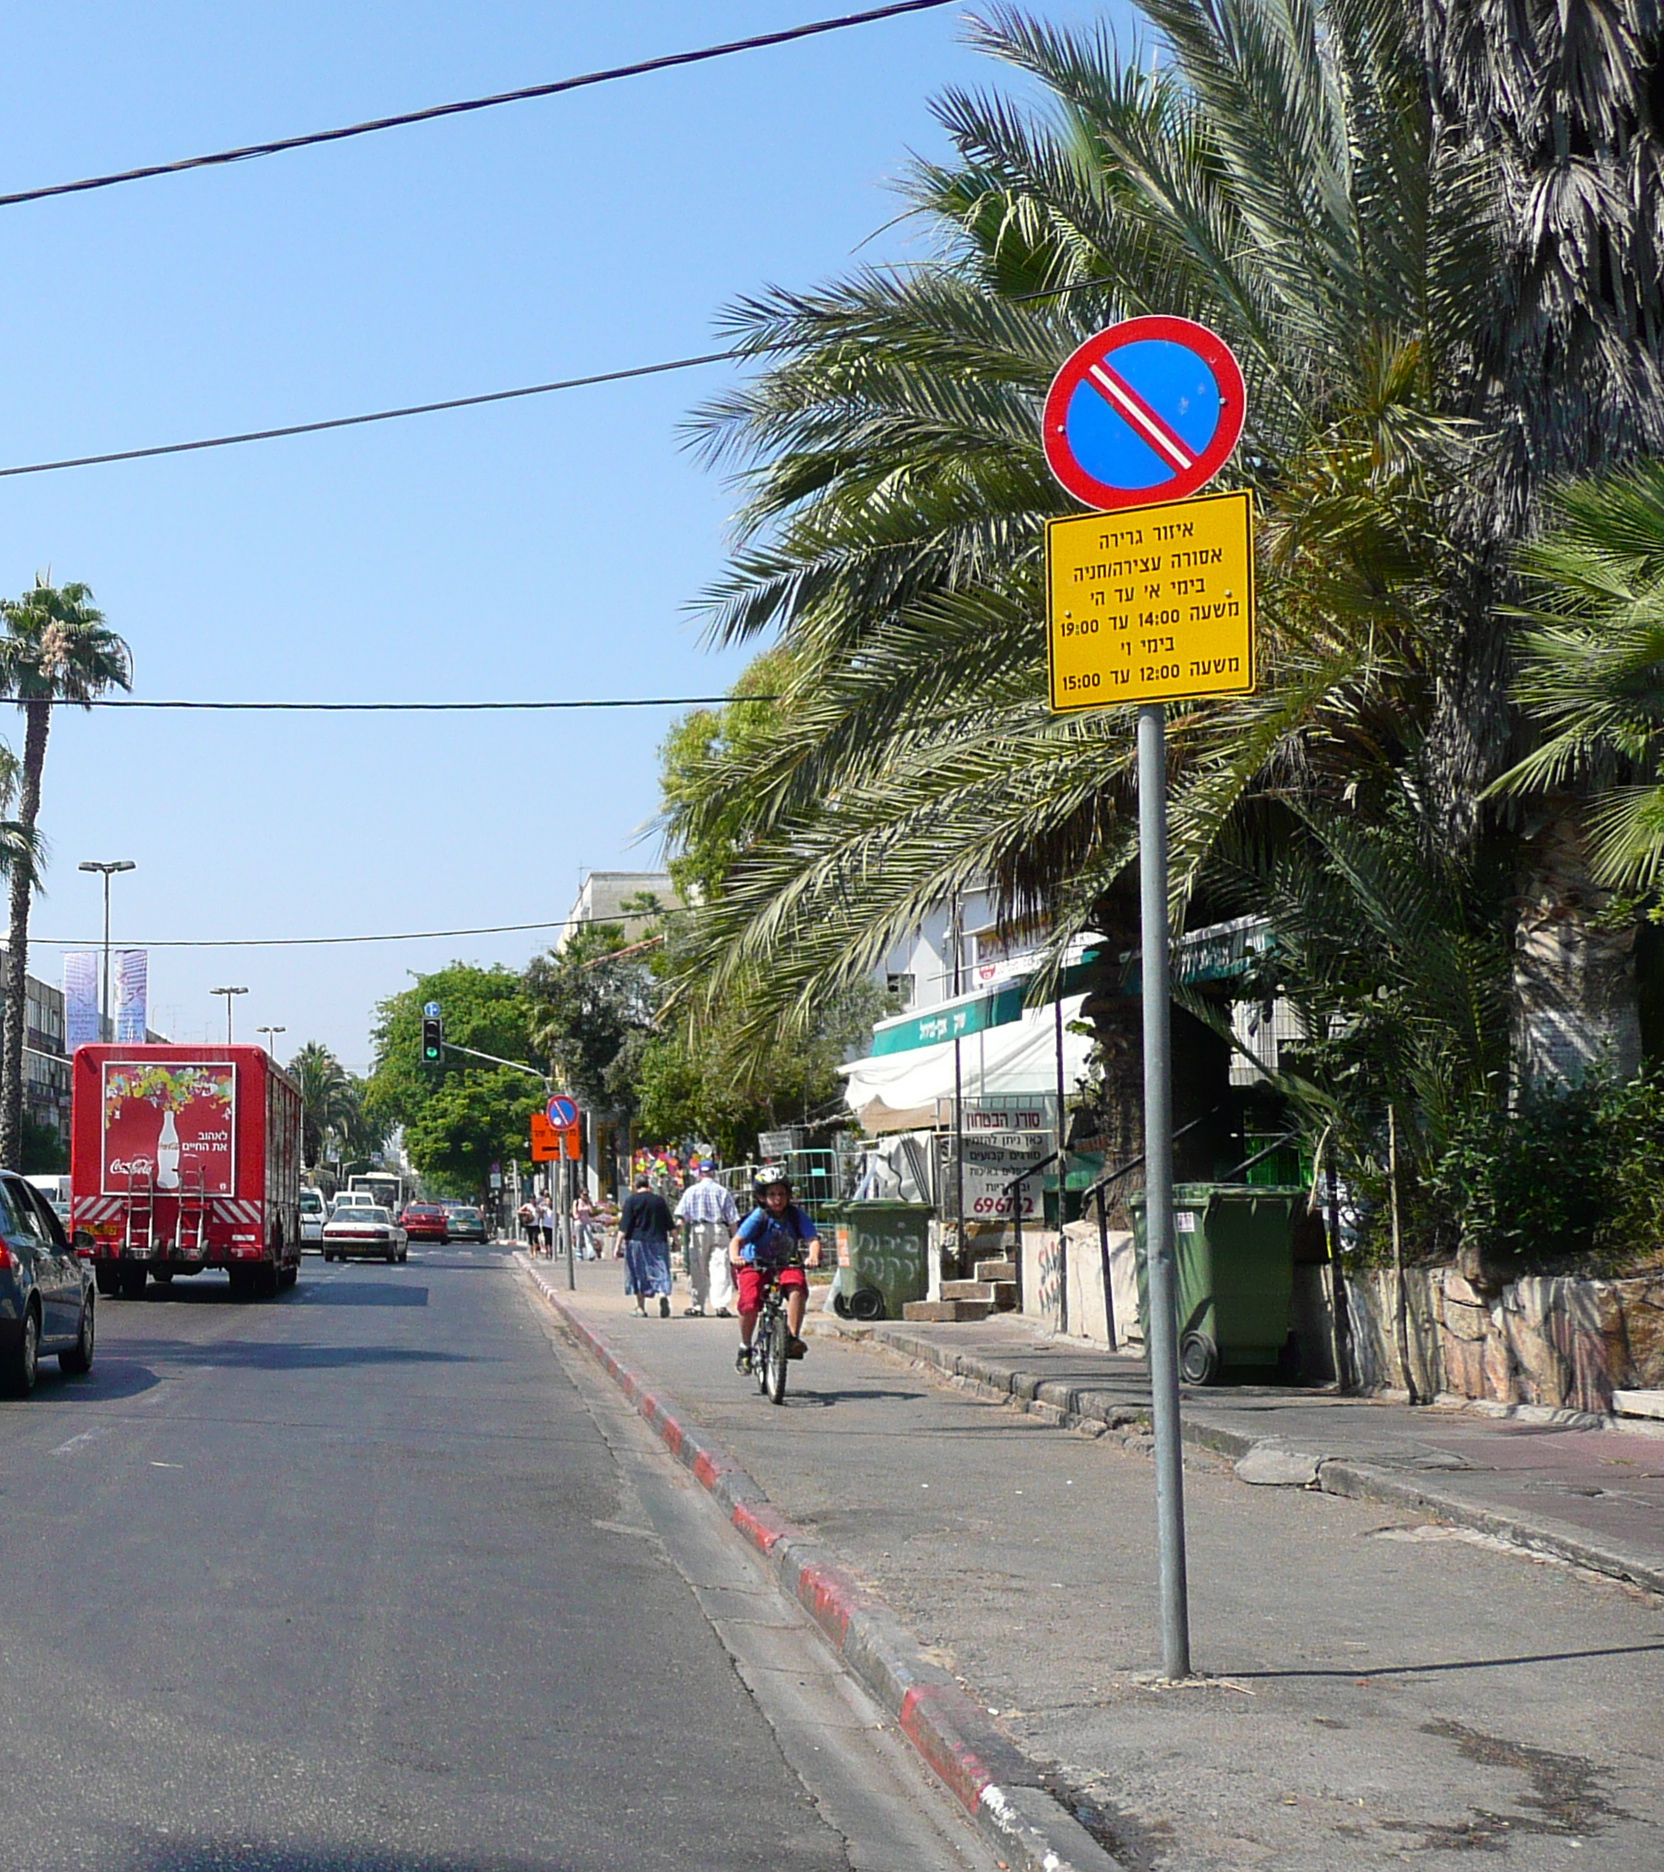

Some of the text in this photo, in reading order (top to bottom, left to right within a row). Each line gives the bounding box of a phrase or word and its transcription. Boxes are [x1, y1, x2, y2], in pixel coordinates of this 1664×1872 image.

[1100, 522, 1194, 550] איזור גרירה
[1073, 548, 1223, 583] אסורה עצירה/חניה
[1114, 587, 1135, 603] עד
[1170, 578, 1205, 595] בימי
[1061, 601, 1240, 638] משעה 14:00 עד 19:00
[1140, 636, 1175, 654] בימי
[1063, 657, 1240, 691] משעה 12:00 עד 15:00
[967, 1113, 1008, 1132] הבטחון
[198, 1130, 228, 1141] לאהוב
[1002, 1137, 1021, 1147] ניתן
[1026, 1136, 1043, 1147] כאן
[182, 1142, 228, 1152] את החיים
[974, 1197, 1034, 1213] 69672
